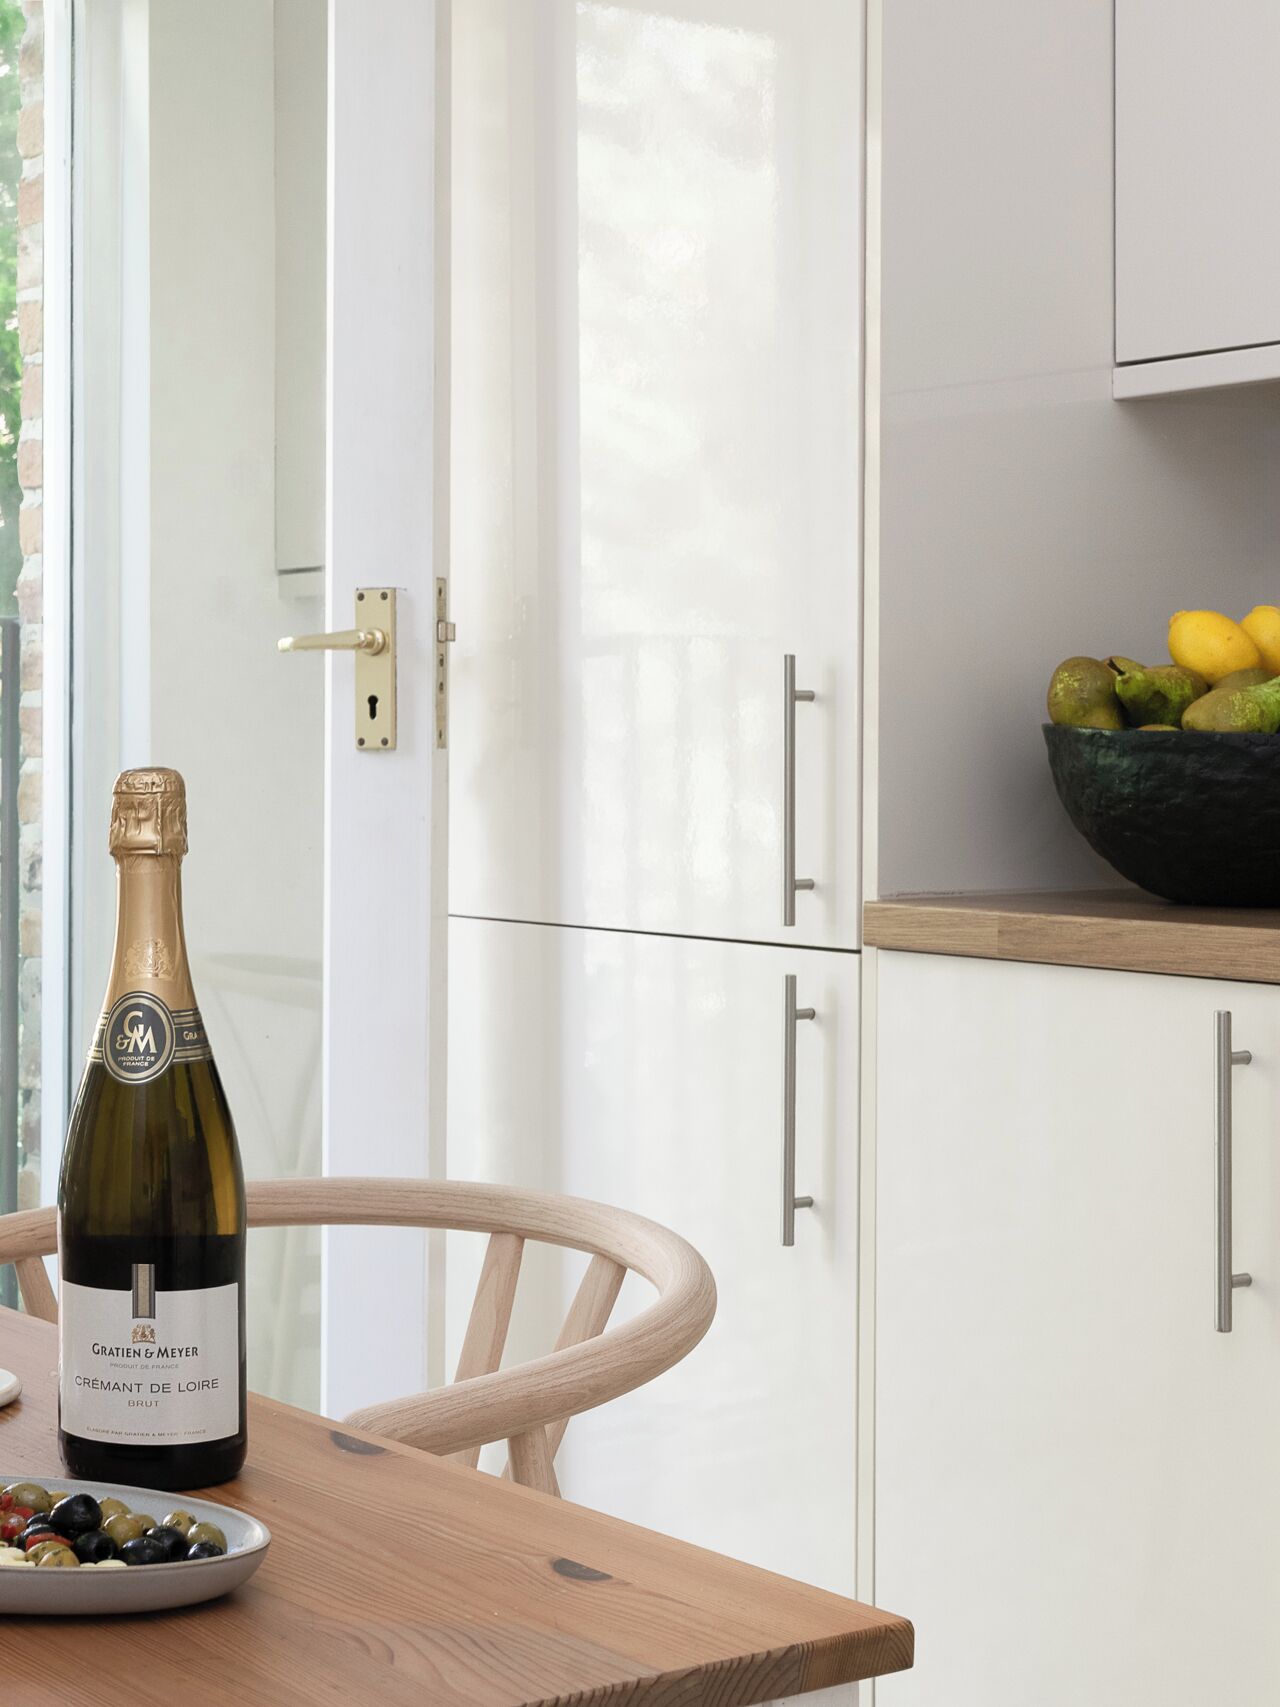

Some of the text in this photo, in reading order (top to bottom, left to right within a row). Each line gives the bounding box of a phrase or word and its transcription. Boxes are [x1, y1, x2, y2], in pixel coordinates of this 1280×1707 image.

[91, 1342, 199, 1359] GRATIEN & MEYER
[74, 1375, 219, 1394] CRÉMANT DE LOIRE
[127, 1399, 160, 1408] BRUT
